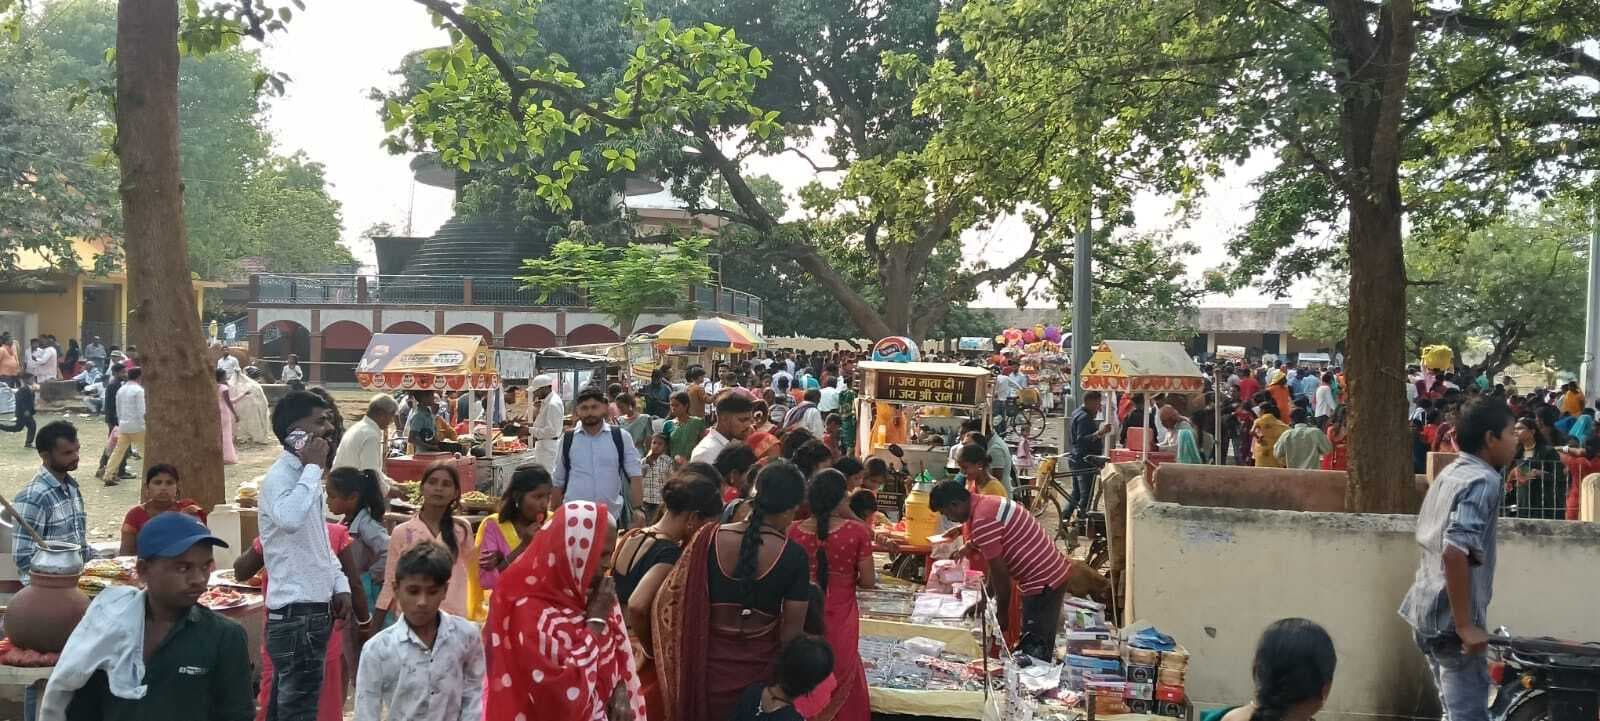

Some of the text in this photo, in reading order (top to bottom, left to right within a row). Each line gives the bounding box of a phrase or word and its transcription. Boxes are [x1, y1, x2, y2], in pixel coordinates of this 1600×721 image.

[898, 377, 916, 387] जय
[919, 378, 941, 388] माता
[943, 378, 955, 390] दी
[898, 390, 917, 400] जय
[918, 390, 933, 401] श्री
[935, 392, 953, 402] राम
